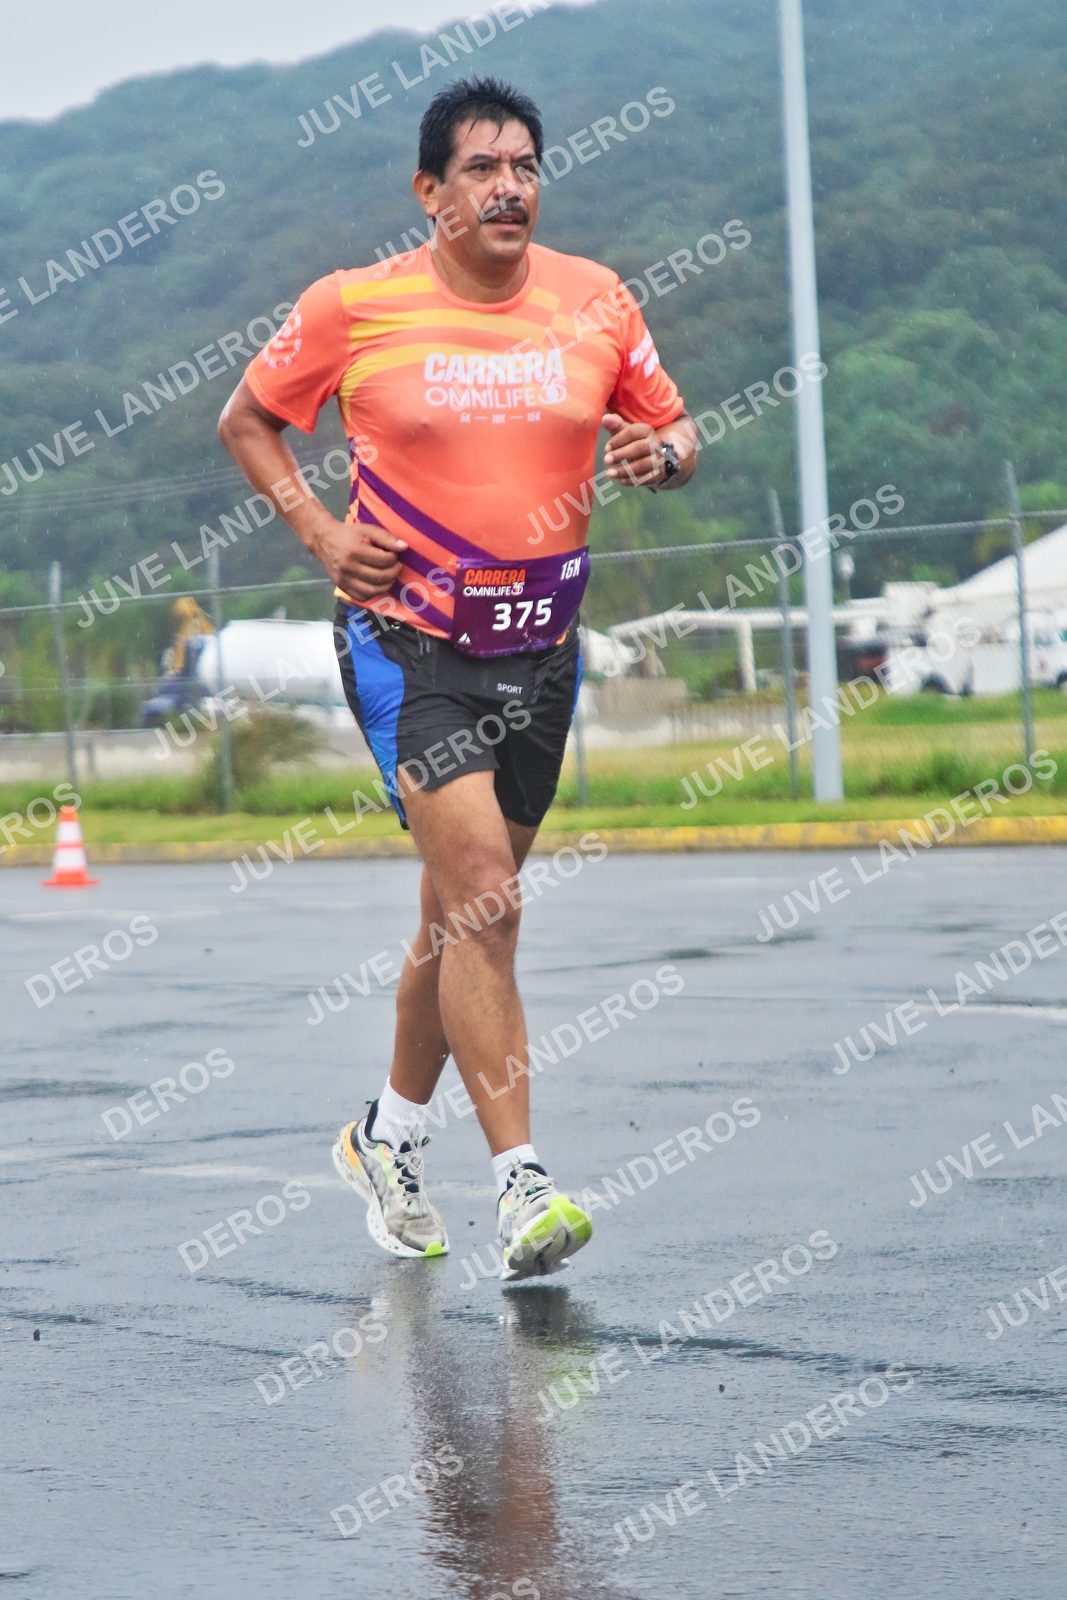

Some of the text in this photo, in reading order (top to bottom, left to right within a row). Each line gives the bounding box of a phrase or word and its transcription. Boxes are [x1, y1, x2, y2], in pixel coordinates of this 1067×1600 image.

[424, 348, 565, 385] CARRERA
[464, 569, 526, 586] CARRERA
[491, 597, 553, 631] 375
[497, 682, 523, 694] SPORT
